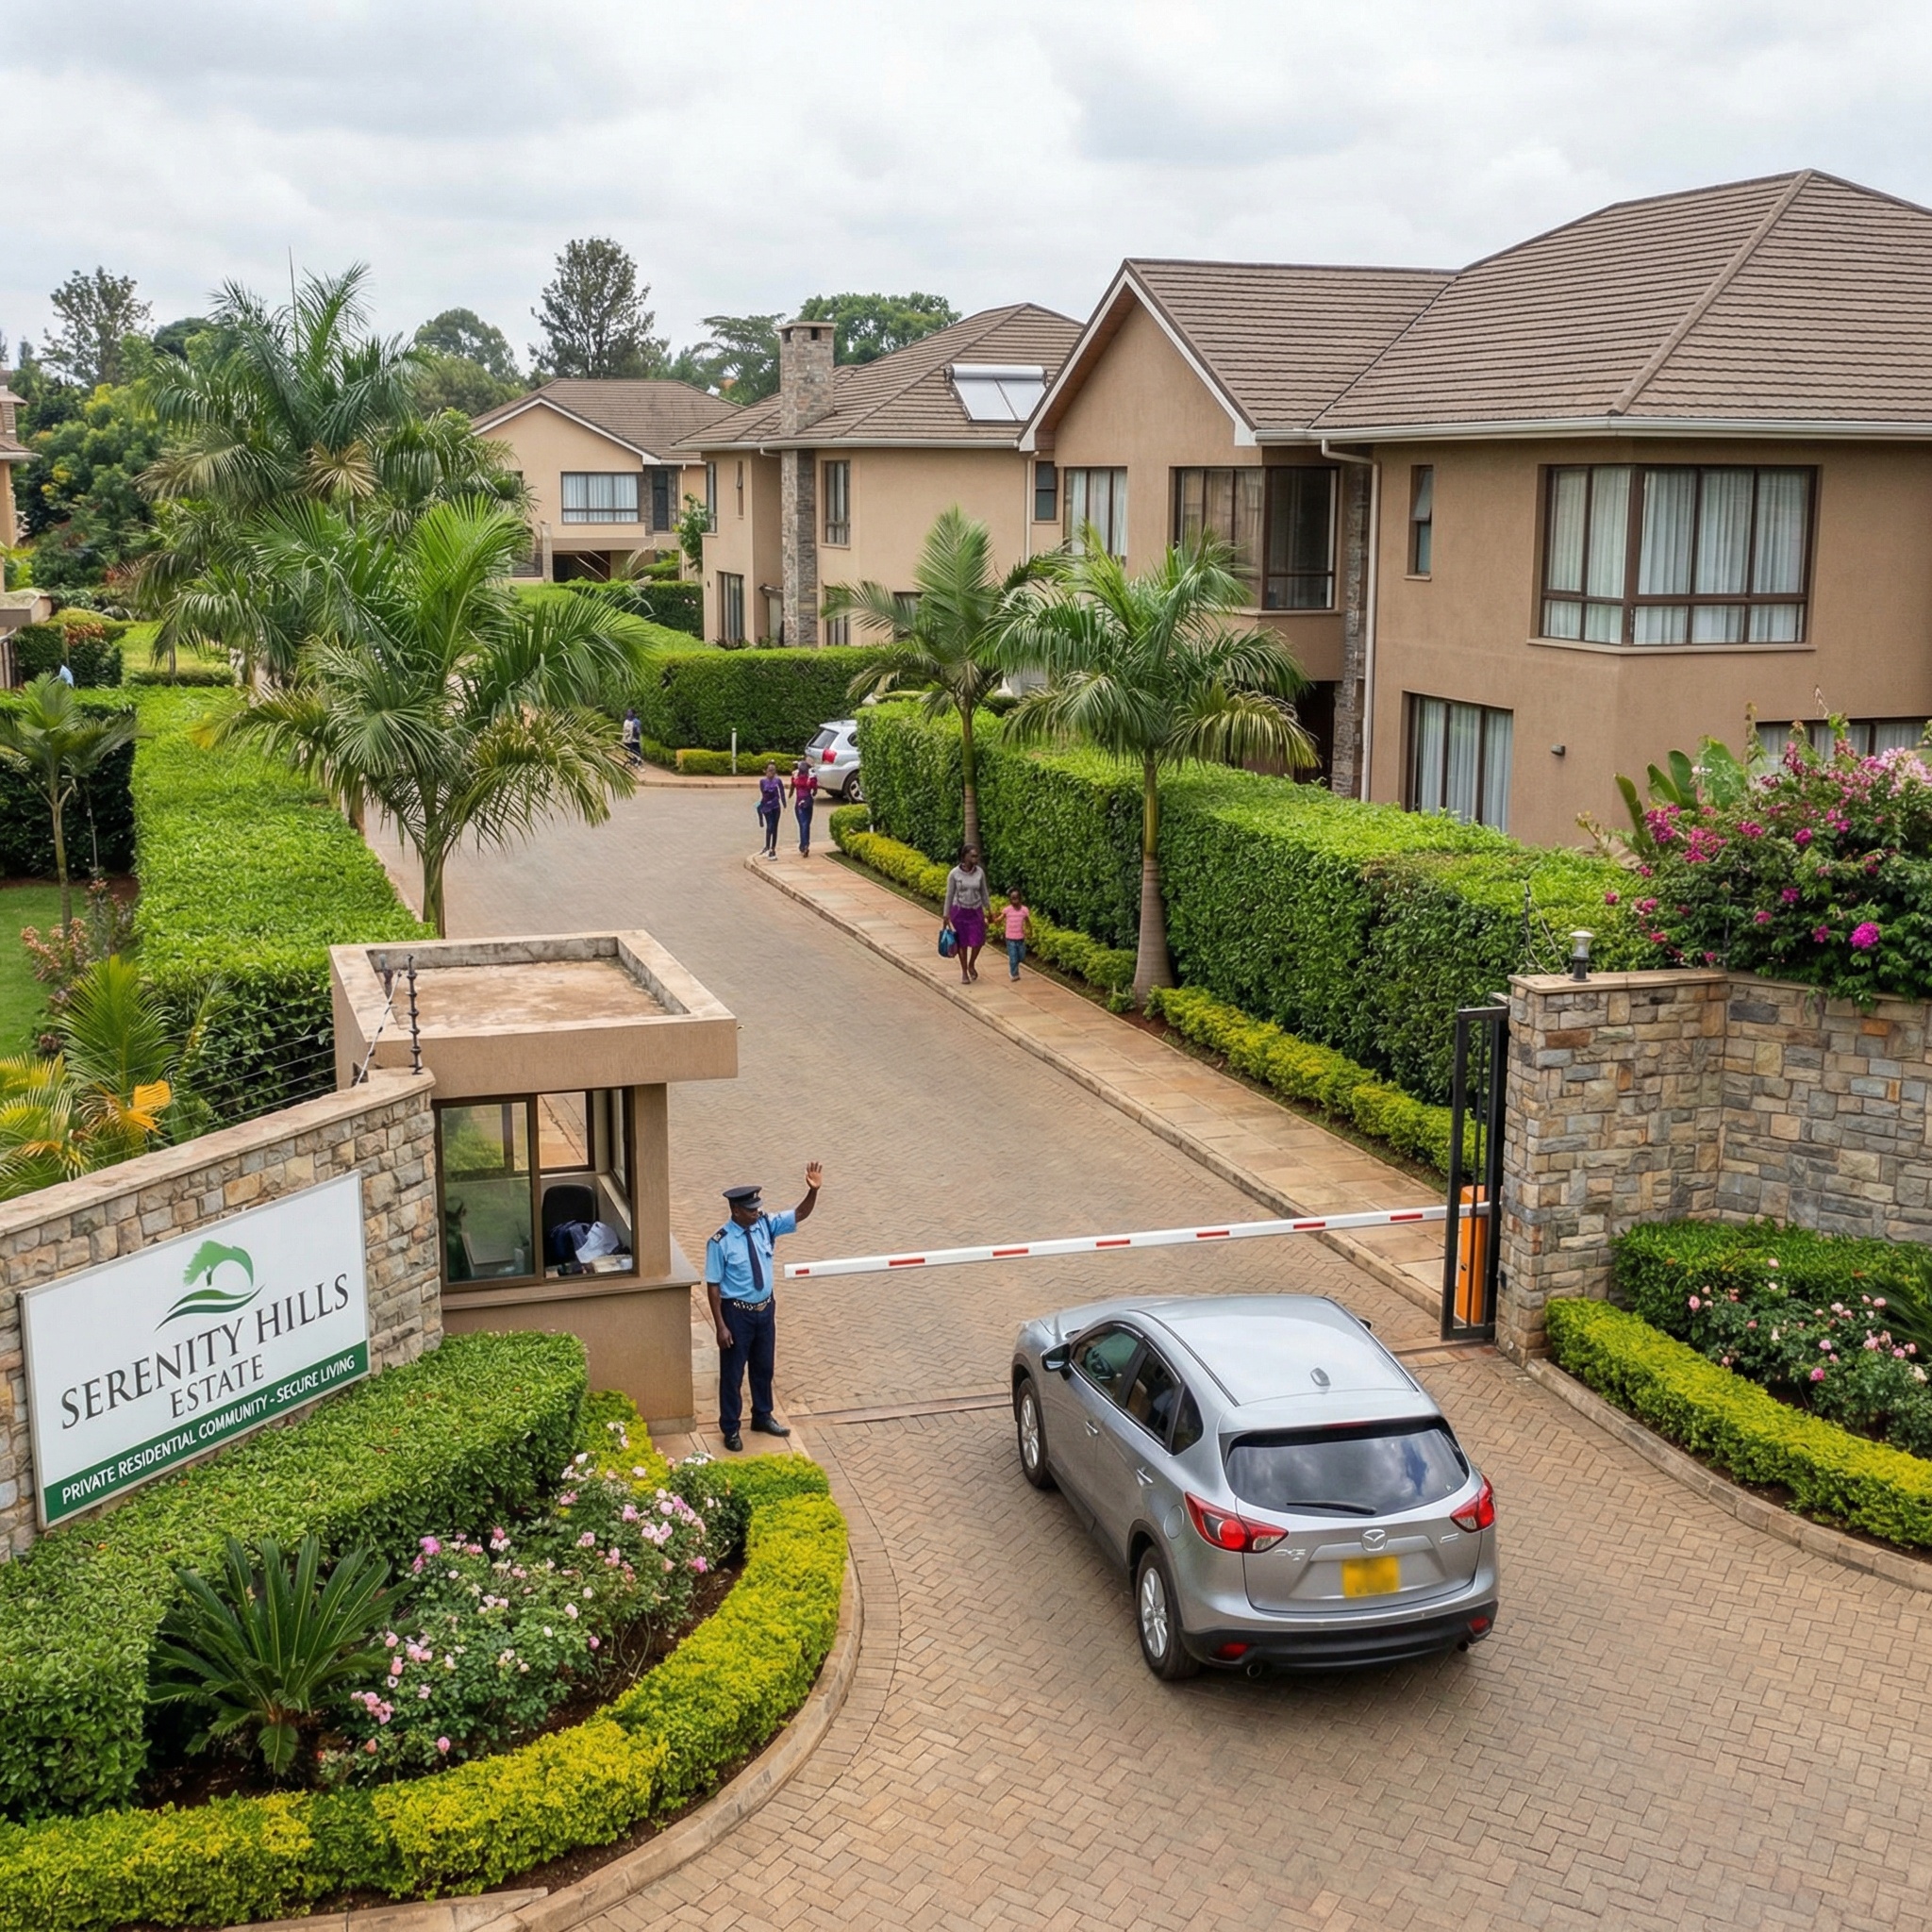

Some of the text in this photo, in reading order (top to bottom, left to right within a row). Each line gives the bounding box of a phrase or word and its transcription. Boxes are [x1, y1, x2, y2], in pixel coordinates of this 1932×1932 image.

[61, 1274, 348, 1429] SERENITY HILLS
[170, 1354, 264, 1418] ESTATE
[61, 1465, 117, 1505] PRIVATE
[118, 1429, 197, 1478] RESIDENTIAL
[198, 1394, 268, 1439] COMMUNITY
[276, 1371, 319, 1404] SECURE
[320, 1355, 356, 1384] LIVING
